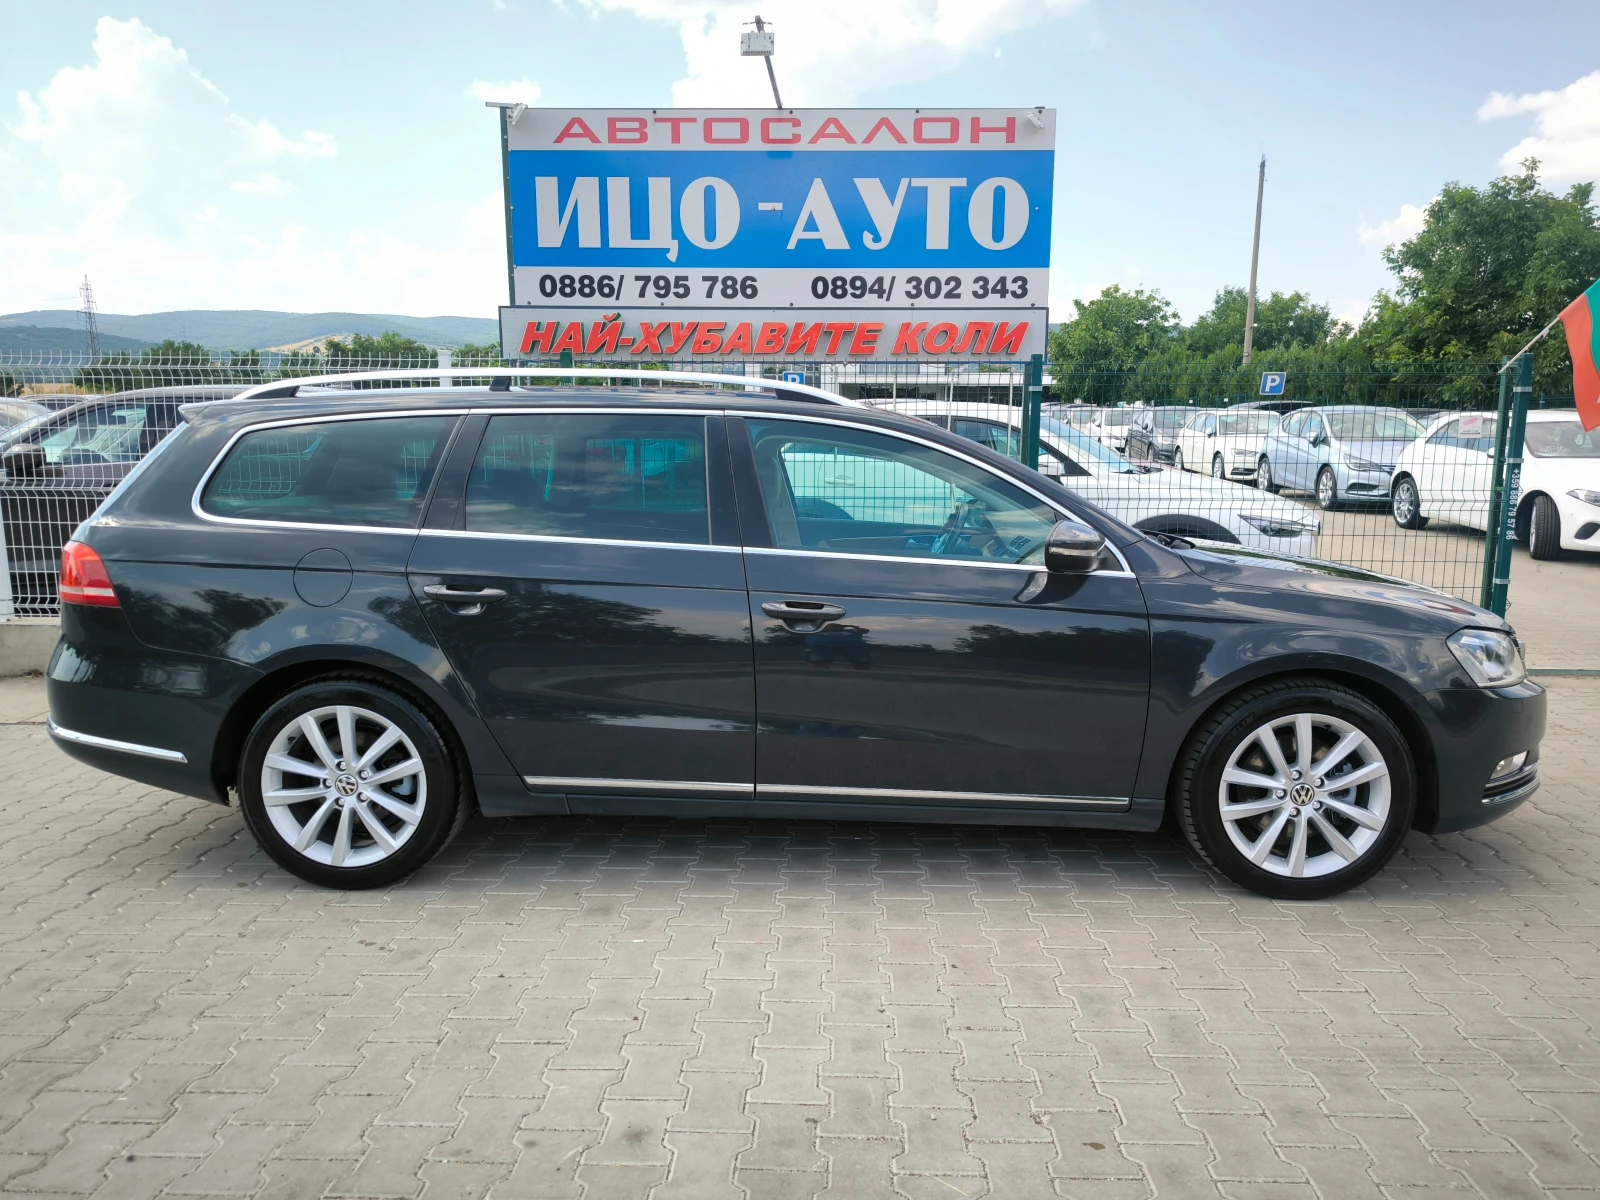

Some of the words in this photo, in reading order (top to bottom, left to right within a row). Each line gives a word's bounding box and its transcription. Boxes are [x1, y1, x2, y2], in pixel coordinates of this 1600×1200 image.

[553, 117, 1016, 144] АВТОСАЛОН
[534, 176, 741, 263] ИЦО
[786, 177, 1029, 251] АУТО
[538, 274, 624, 301] 0886/
[634, 275, 691, 299] 795
[701, 275, 759, 299] 786
[810, 275, 896, 301] 0894/
[905, 275, 962, 299] 302
[972, 275, 1029, 299] 343
[519, 312, 882, 355] НАЙ-ХУБАВИТЕ
[891, 321, 1030, 356] КОЛИ
[1265, 375, 1280, 392] P
[1511, 469, 1520, 488] +359
[1509, 490, 1518, 505] 886
[1508, 506, 1517, 516] 79
[1507, 518, 1516, 528] 57
[1506, 530, 1515, 540] 86
